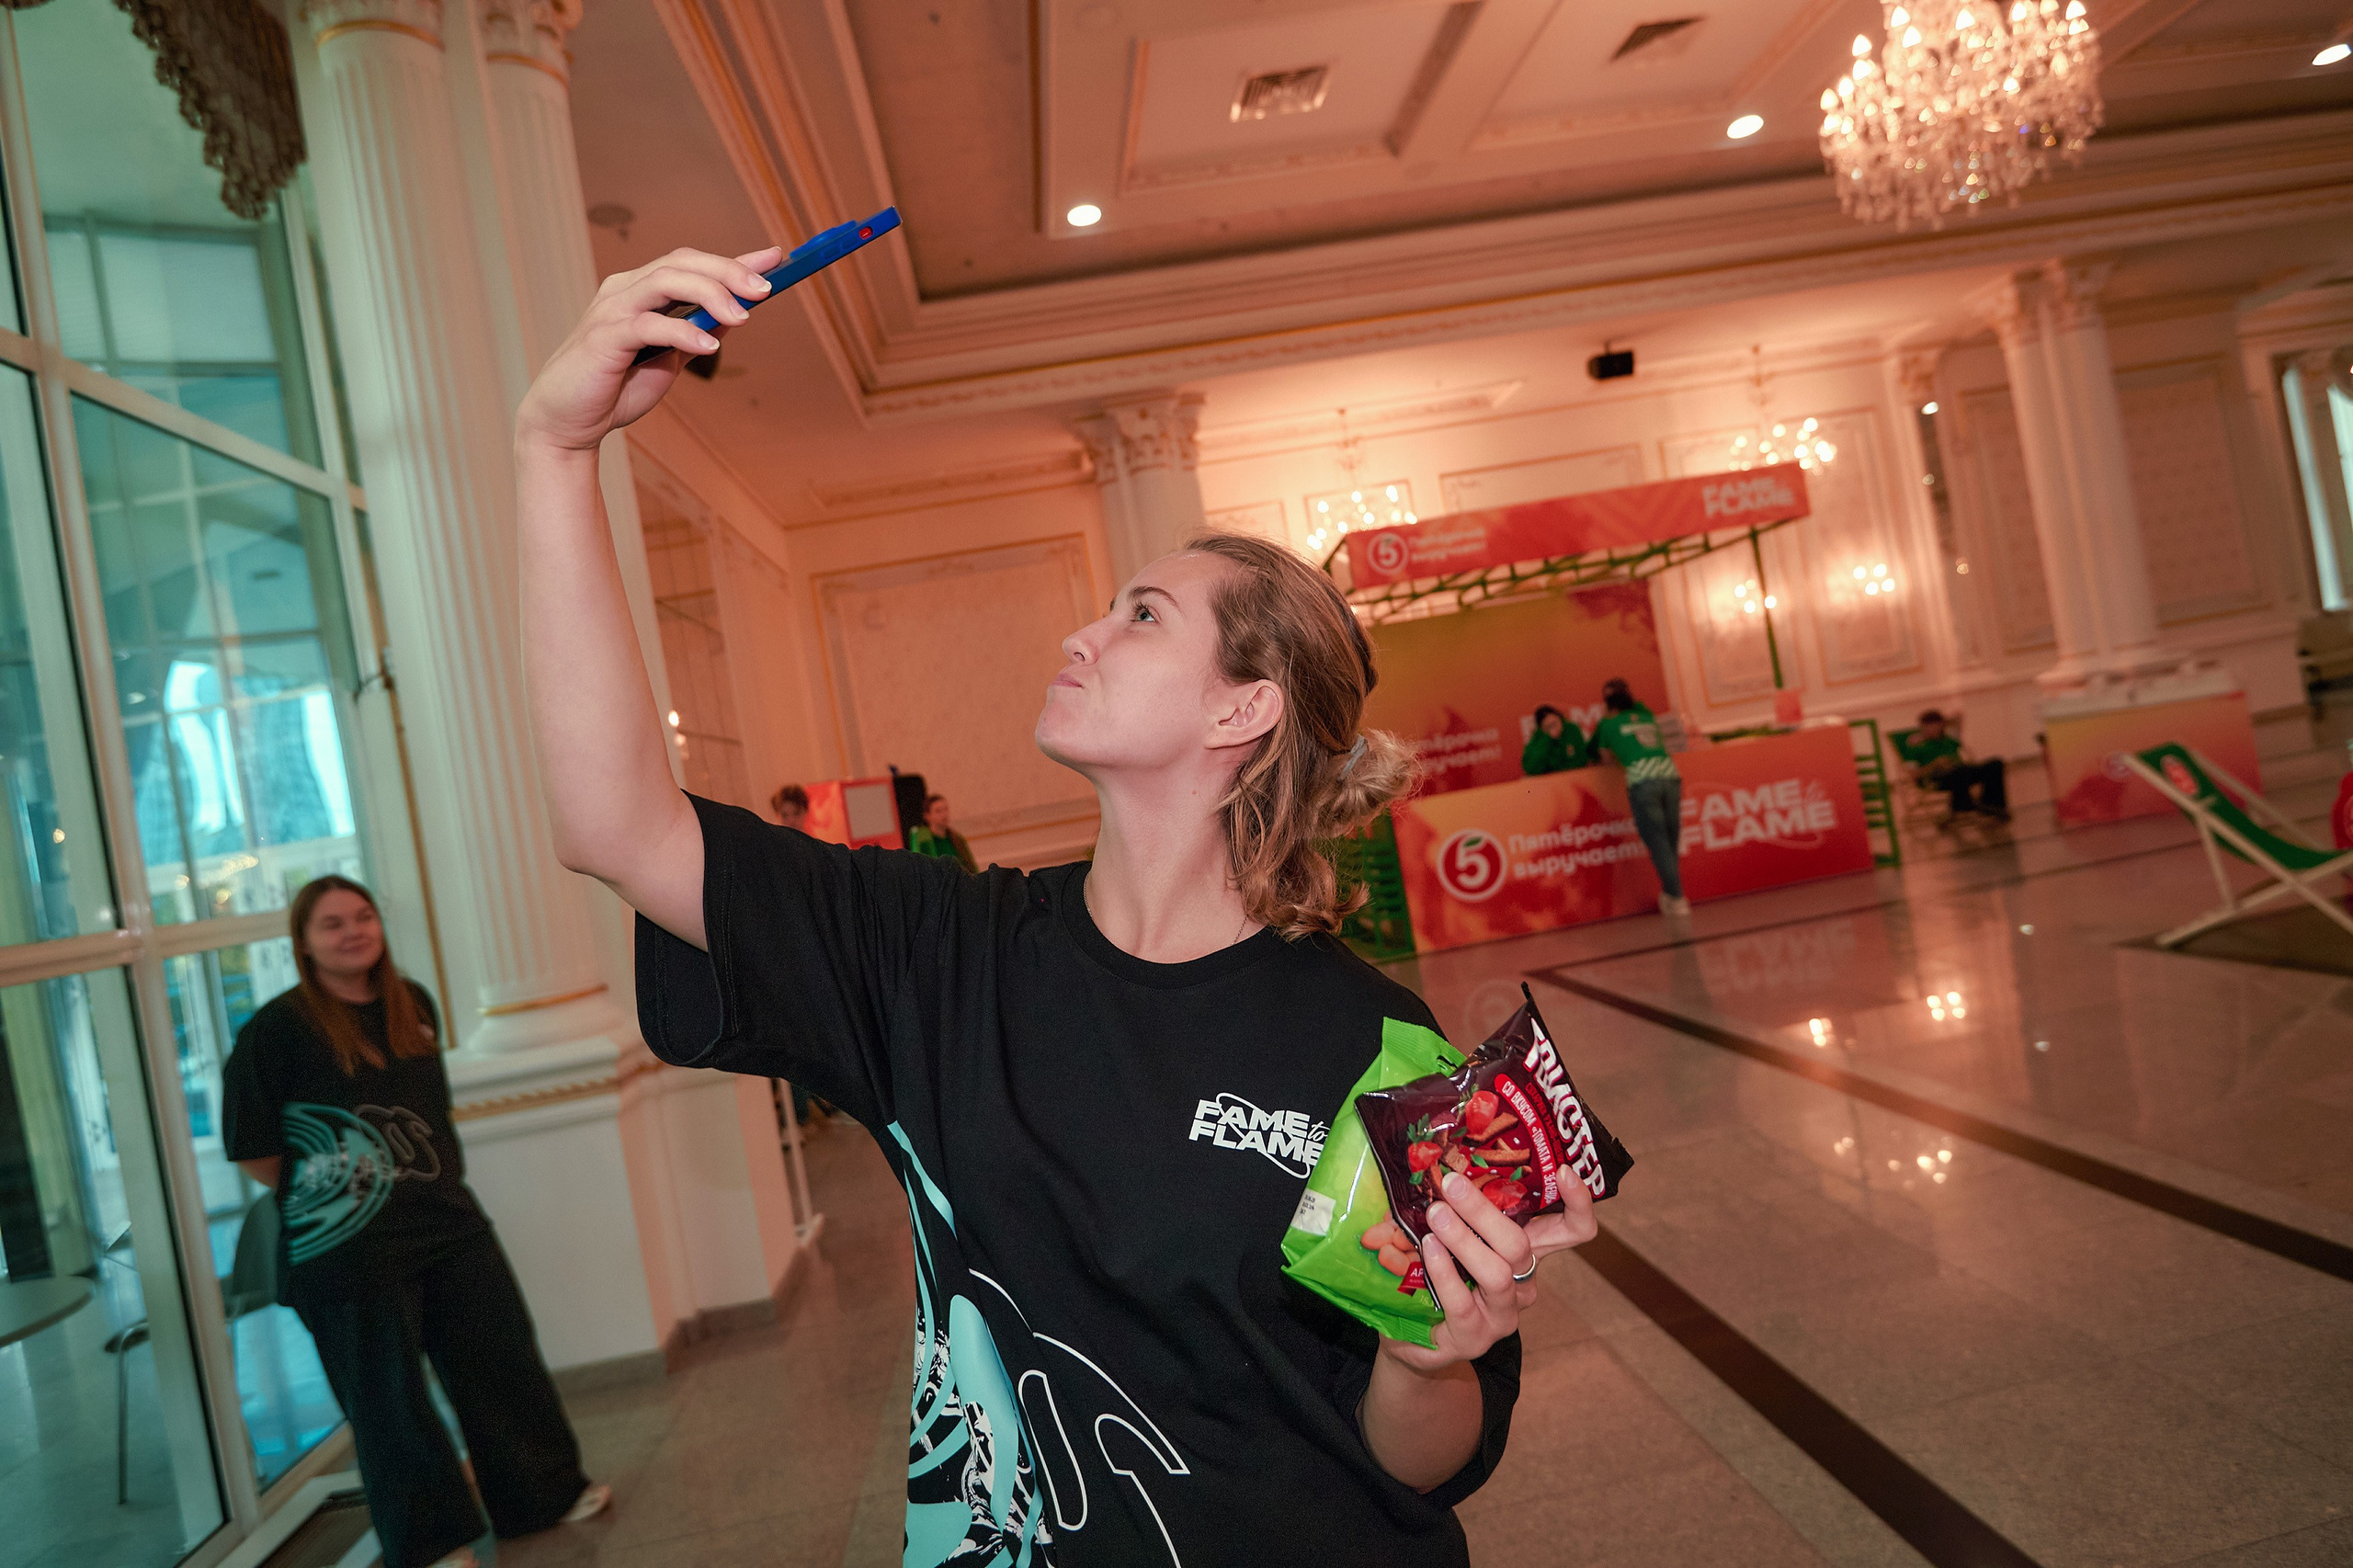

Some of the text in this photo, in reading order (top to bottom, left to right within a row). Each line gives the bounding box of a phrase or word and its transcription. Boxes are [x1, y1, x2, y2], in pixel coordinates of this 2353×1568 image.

[1379, 537, 1398, 566] 5
[1677, 800, 1835, 857] FLAME
[1456, 834, 1490, 889] 5
[1188, 1119, 1324, 1166] FLAME
[1195, 1099, 1331, 1142] FAME to
[1501, 1080, 1517, 1098] СО
[1511, 1091, 1537, 1127] ВКУСОМ
[1531, 1126, 1552, 1165] «ТОМАТА
[1544, 1165, 1554, 1173] И
